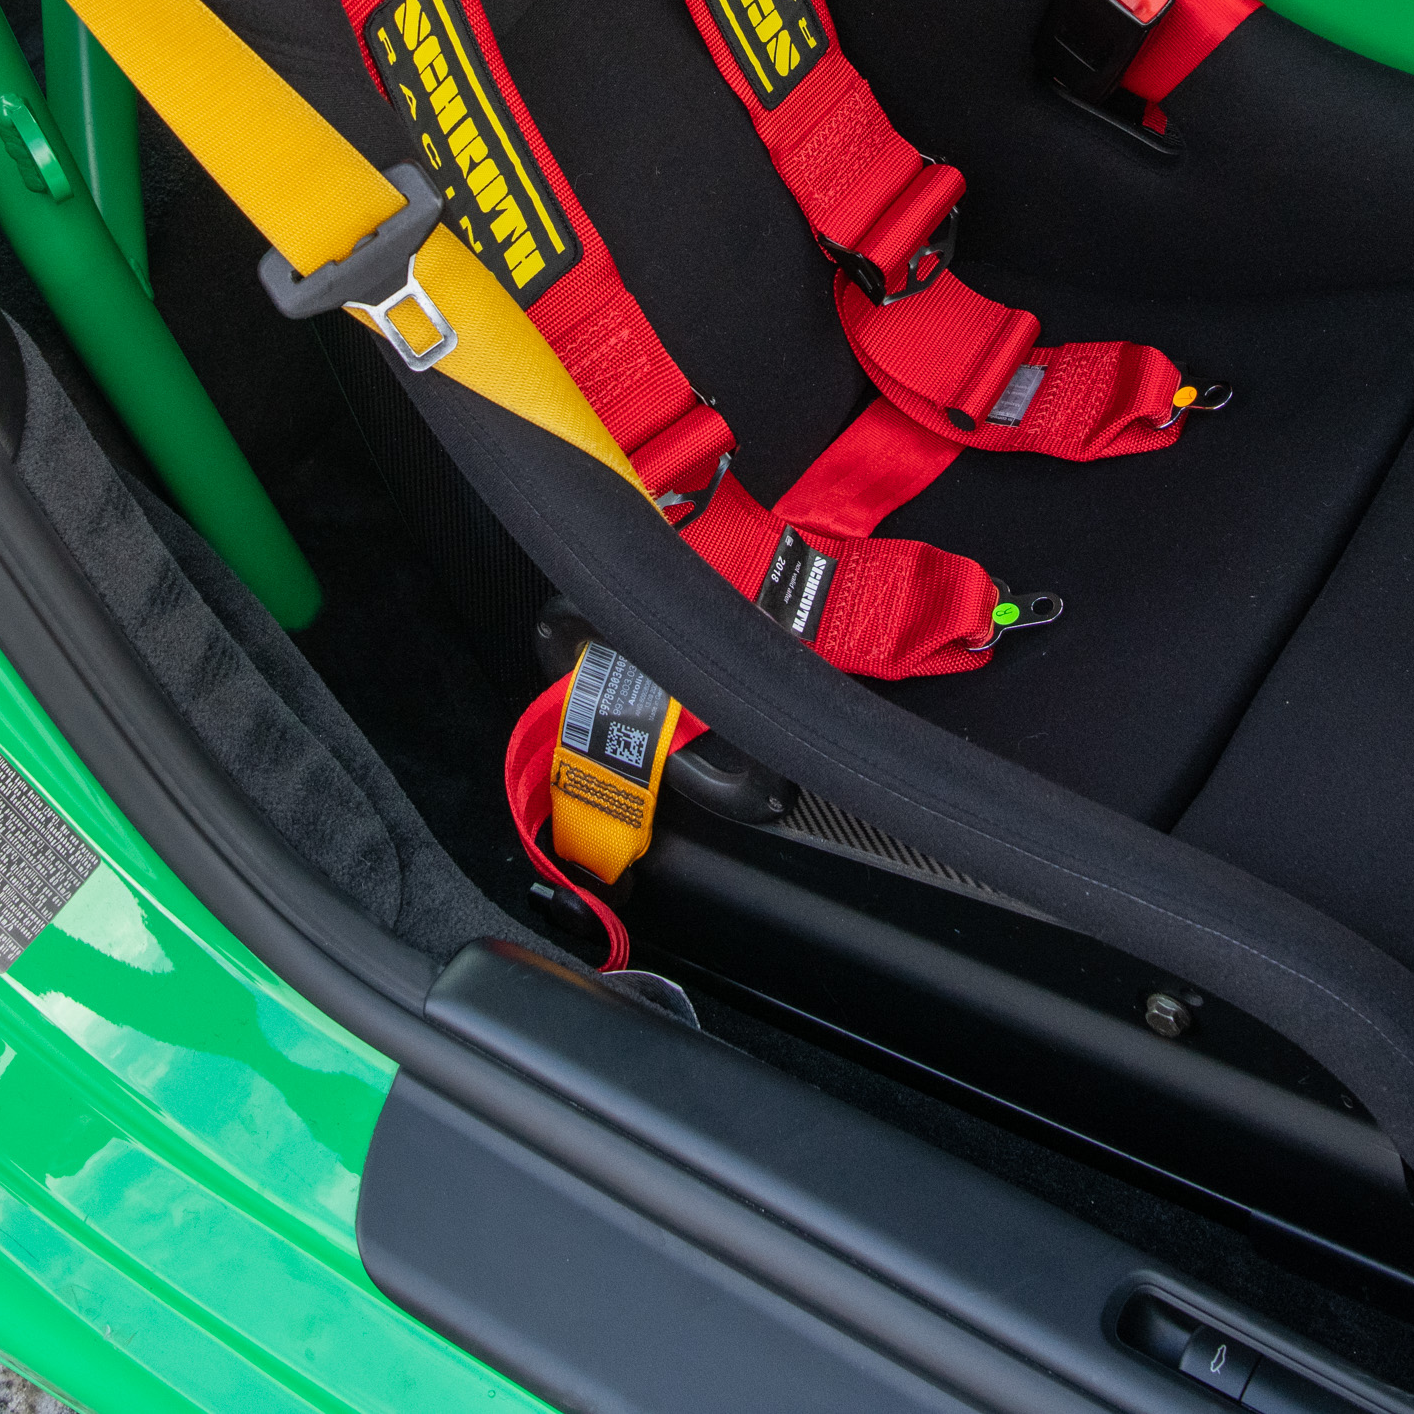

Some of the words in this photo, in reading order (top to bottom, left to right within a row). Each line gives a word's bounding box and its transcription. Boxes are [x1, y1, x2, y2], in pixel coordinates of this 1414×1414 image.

[377, 26, 484, 255] RACIN
[771, 555, 786, 583] 2018
[789, 573, 798, 589] valid
[794, 561, 802, 573] not
[784, 587, 792, 604] after
[792, 556, 827, 633] SCHROTH
[628, 673, 644, 706] Autoliv
